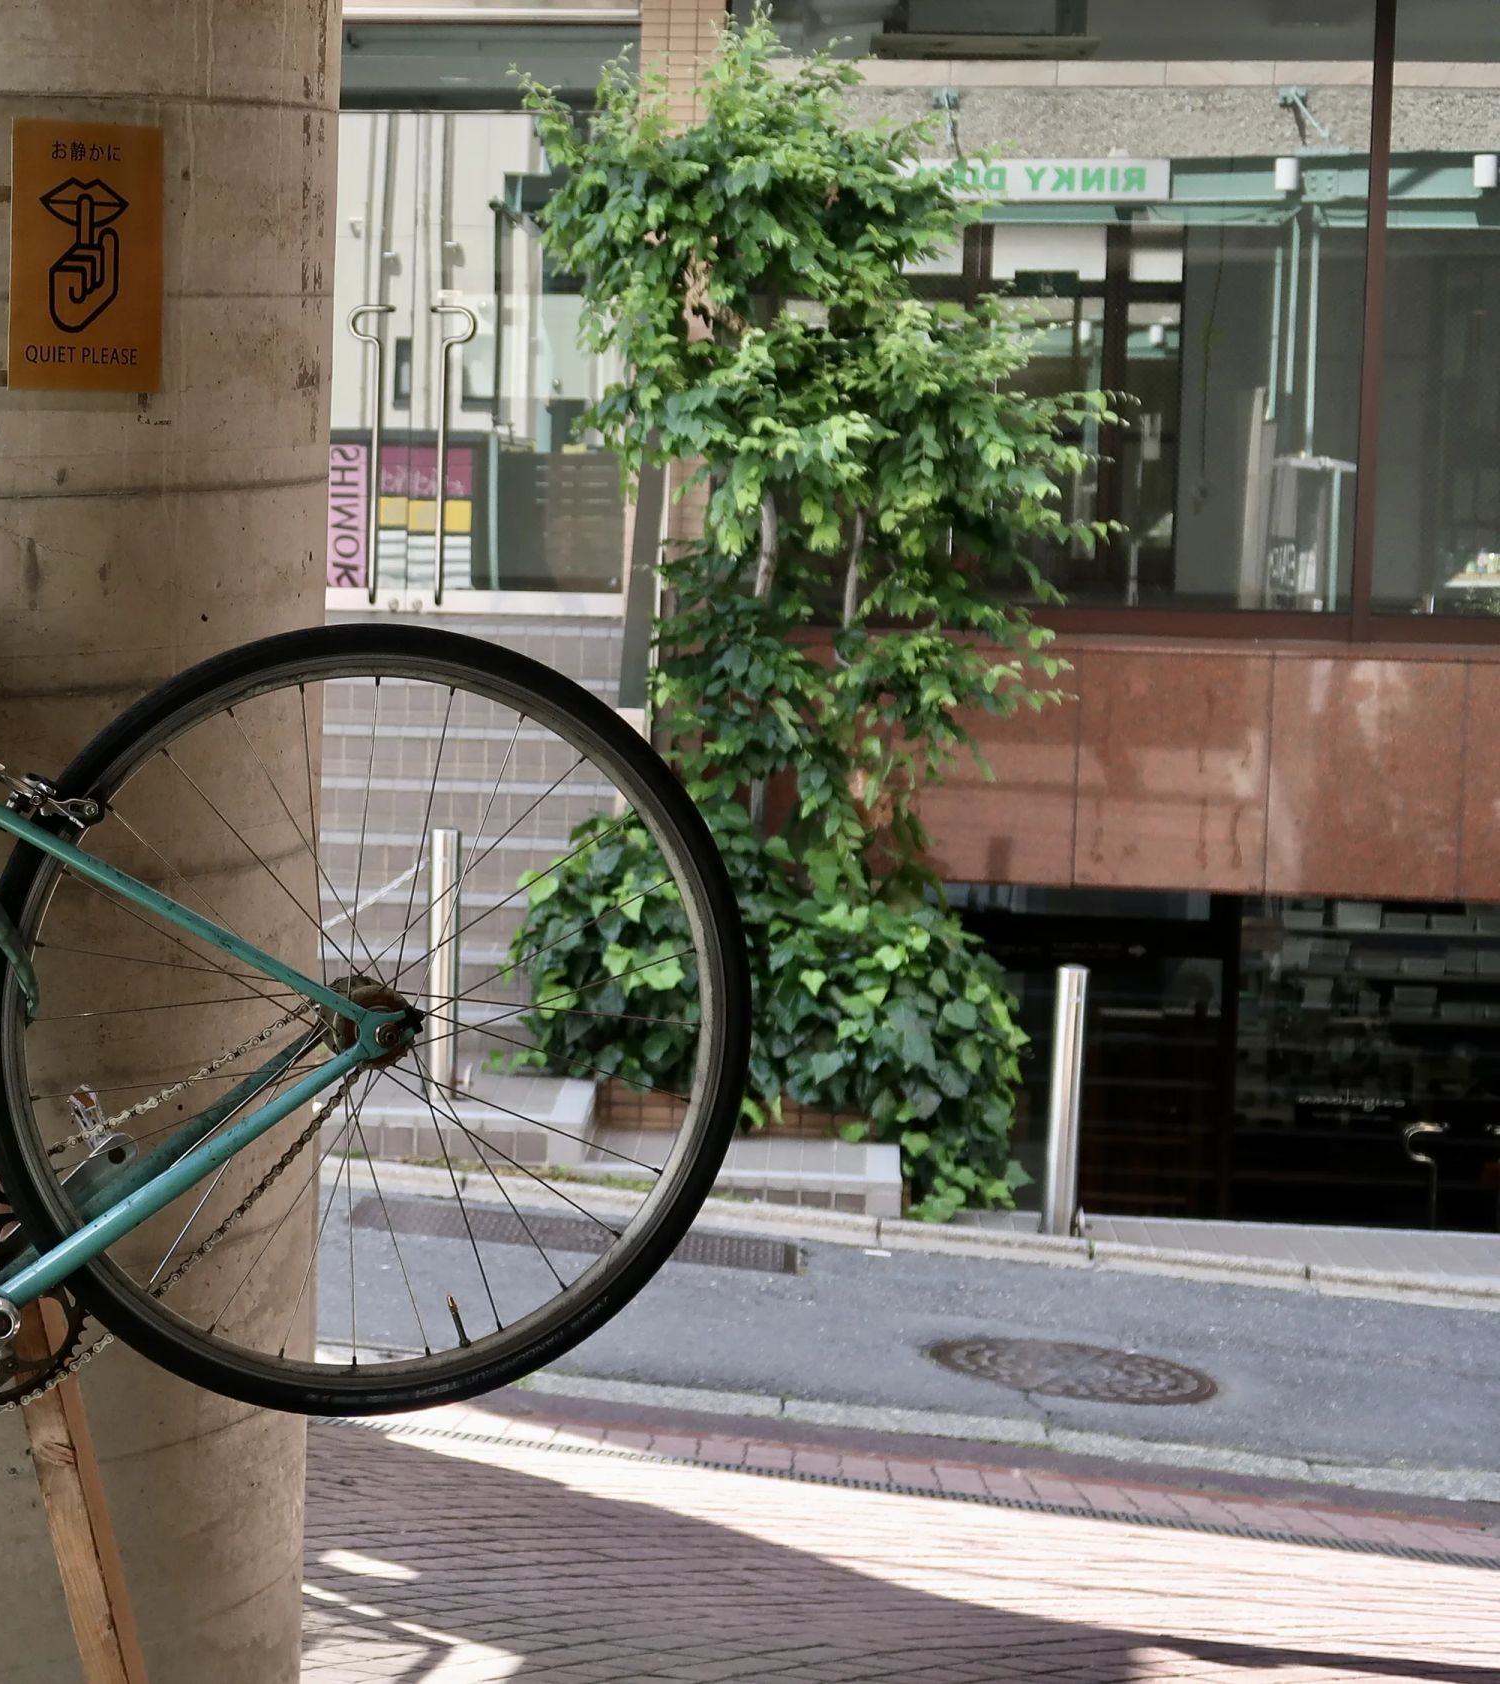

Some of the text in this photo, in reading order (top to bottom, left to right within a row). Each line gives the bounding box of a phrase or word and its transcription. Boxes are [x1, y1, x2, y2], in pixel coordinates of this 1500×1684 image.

[51, 141, 122, 162] お静かに
[25, 345, 138, 365] QUIET PLEASE
